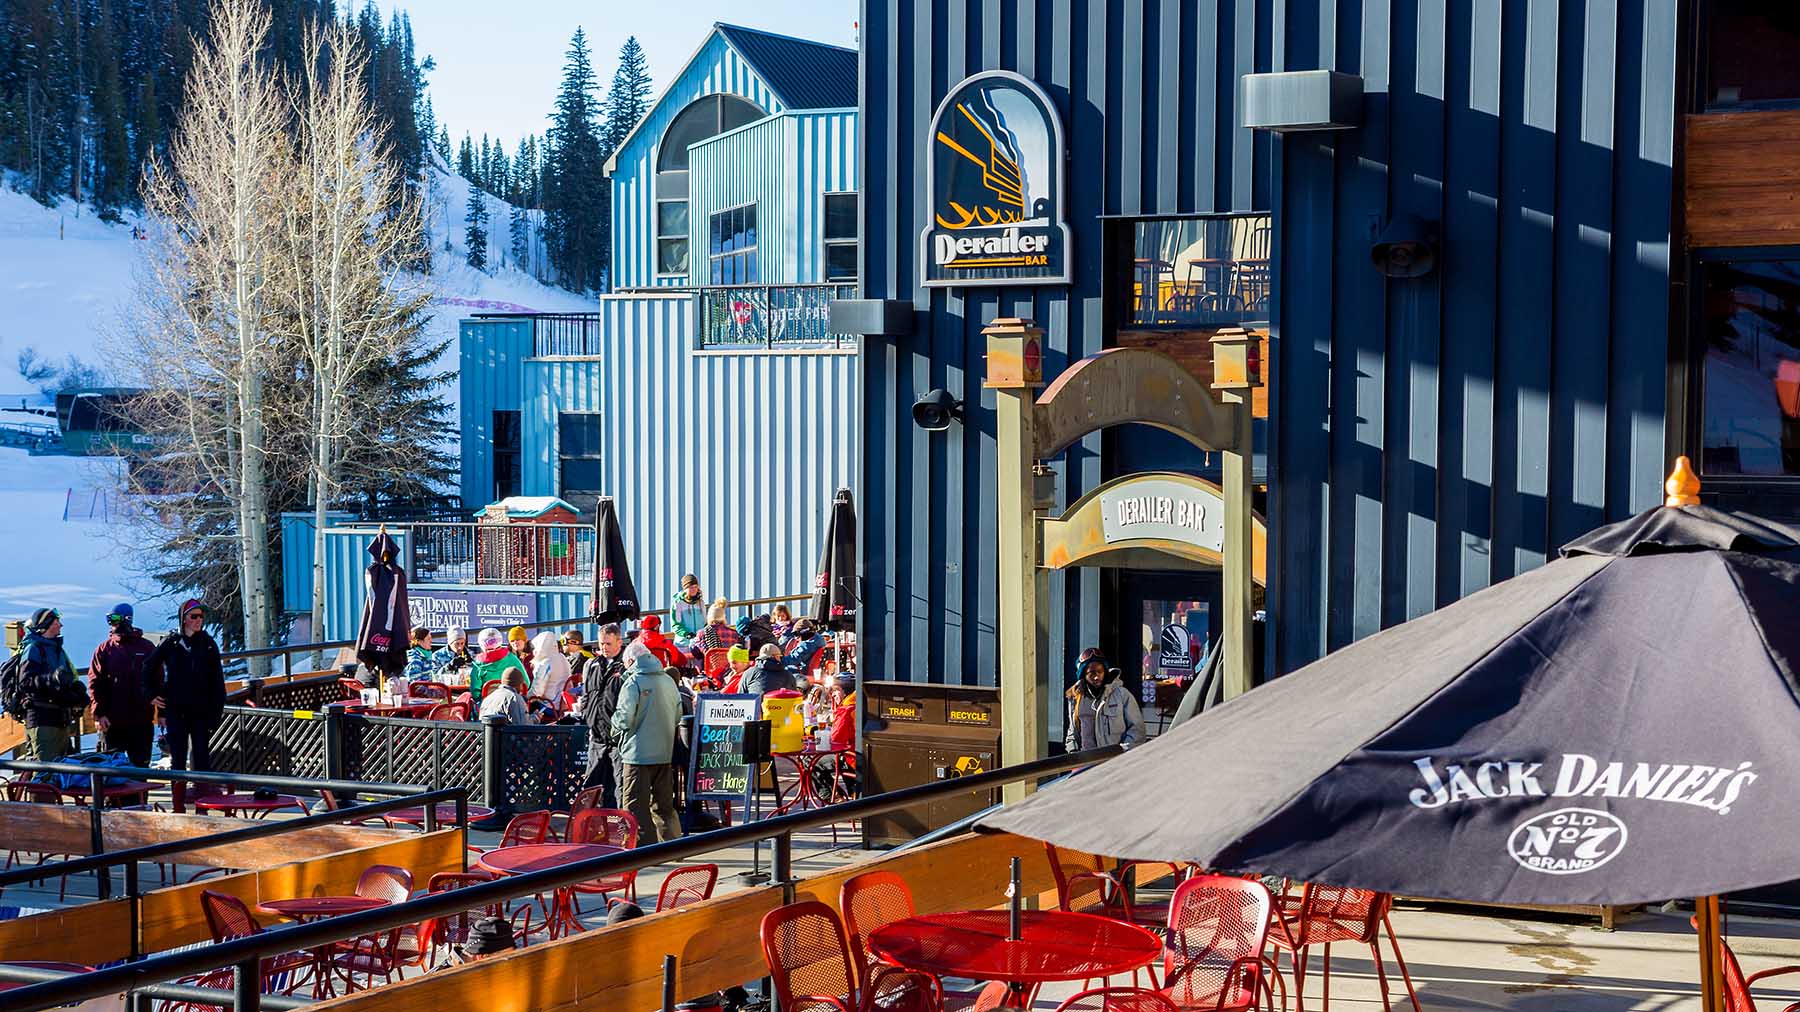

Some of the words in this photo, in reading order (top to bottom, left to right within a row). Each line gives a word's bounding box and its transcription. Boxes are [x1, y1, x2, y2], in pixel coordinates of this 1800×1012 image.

[935, 227, 1049, 265] Derailer
[1025, 256, 1047, 265] BAR
[1118, 496, 1174, 527] DERAILER
[1178, 499, 1206, 532] BAR
[427, 597, 469, 613] DENVER
[476, 604, 498, 615] EAST
[499, 604, 529, 615] GRAND
[427, 613, 469, 629] HEALTH
[710, 708, 745, 719] FINLANDIA
[889, 707, 915, 717] TRASH
[950, 711, 987, 721] RECYCLE
[700, 753, 721, 769] JACK
[722, 772, 748, 793] Honey
[1409, 756, 1546, 809] JACK
[1552, 814, 1597, 827] OLD
[1528, 856, 1595, 870] BRAND
